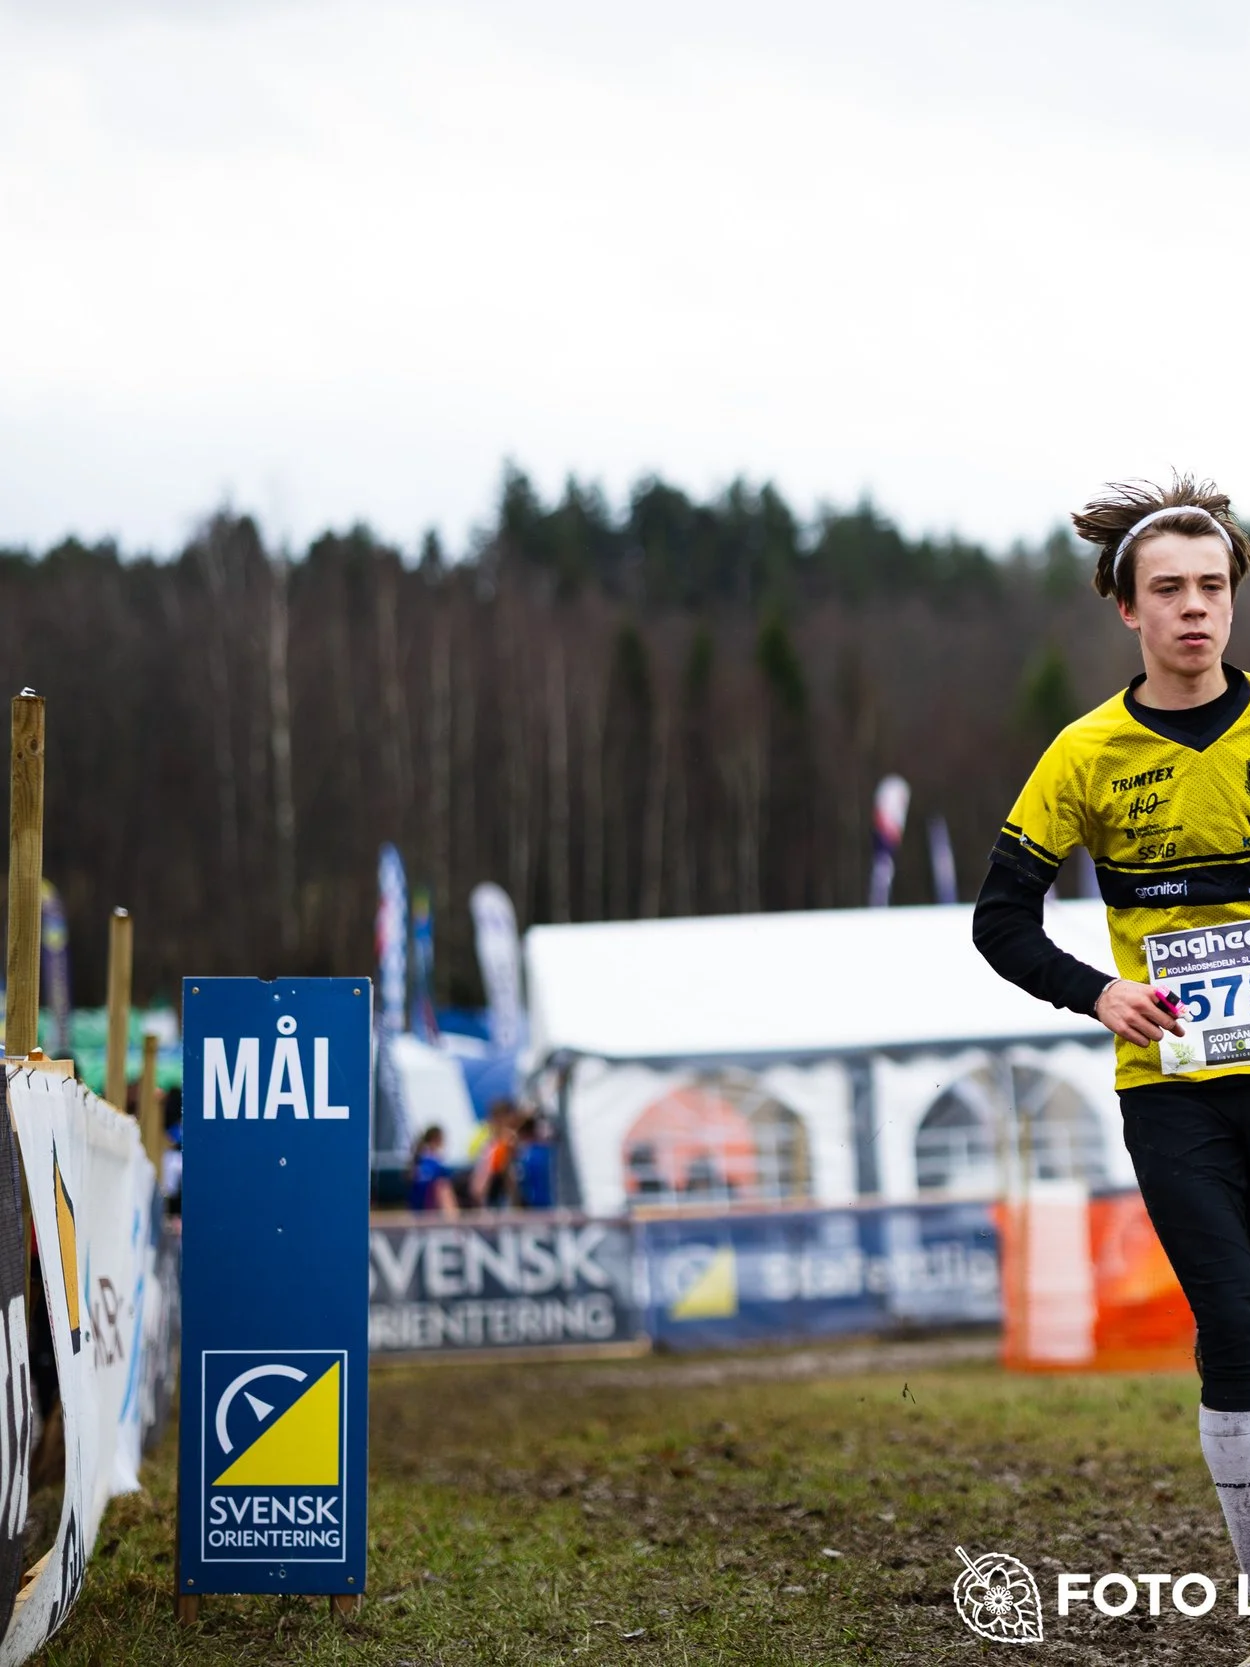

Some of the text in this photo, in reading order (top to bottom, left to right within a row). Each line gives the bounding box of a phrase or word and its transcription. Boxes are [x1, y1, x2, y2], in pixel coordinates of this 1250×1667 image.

[1111, 765, 1175, 794] TRIMTEX
[1138, 842, 1178, 861] SSAB
[1167, 959, 1236, 975] KOLMÅRDSMEDELN
[1242, 956, 1250, 964] SL
[203, 1015, 350, 1120] MÅL
[370, 1224, 610, 1299] VENSK
[370, 1293, 616, 1350] RIENTERING
[208, 1496, 339, 1525] SVENSK
[208, 1530, 340, 1548] ORIENTERING
